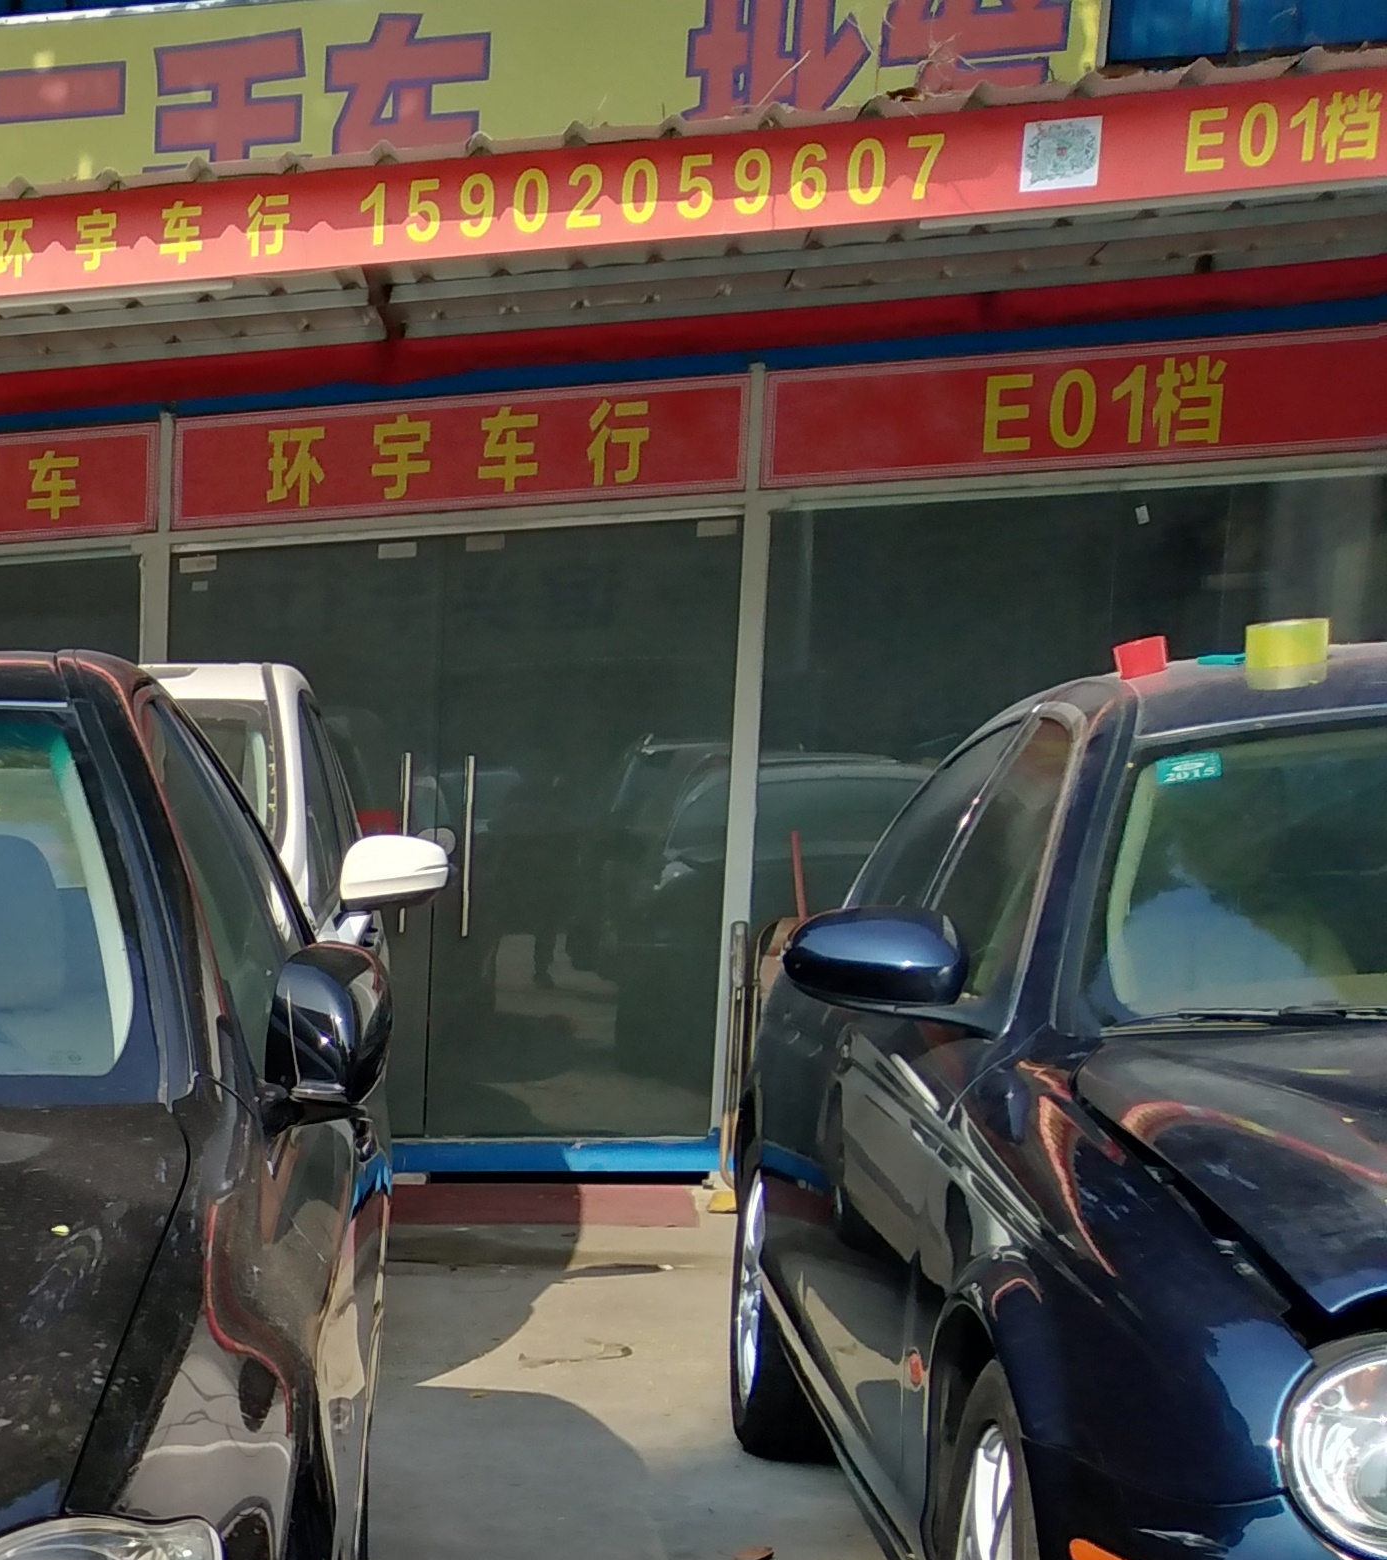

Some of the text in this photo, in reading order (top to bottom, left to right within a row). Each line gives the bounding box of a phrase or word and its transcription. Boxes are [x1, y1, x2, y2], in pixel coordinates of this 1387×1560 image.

[359, 133, 945, 247] 15902059607
[1184, 90, 1383, 173] E01档
[267, 402, 650, 507] 环宇车行
[982, 356, 1225, 453] E01档
[1163, 766, 1217, 783] 2015
